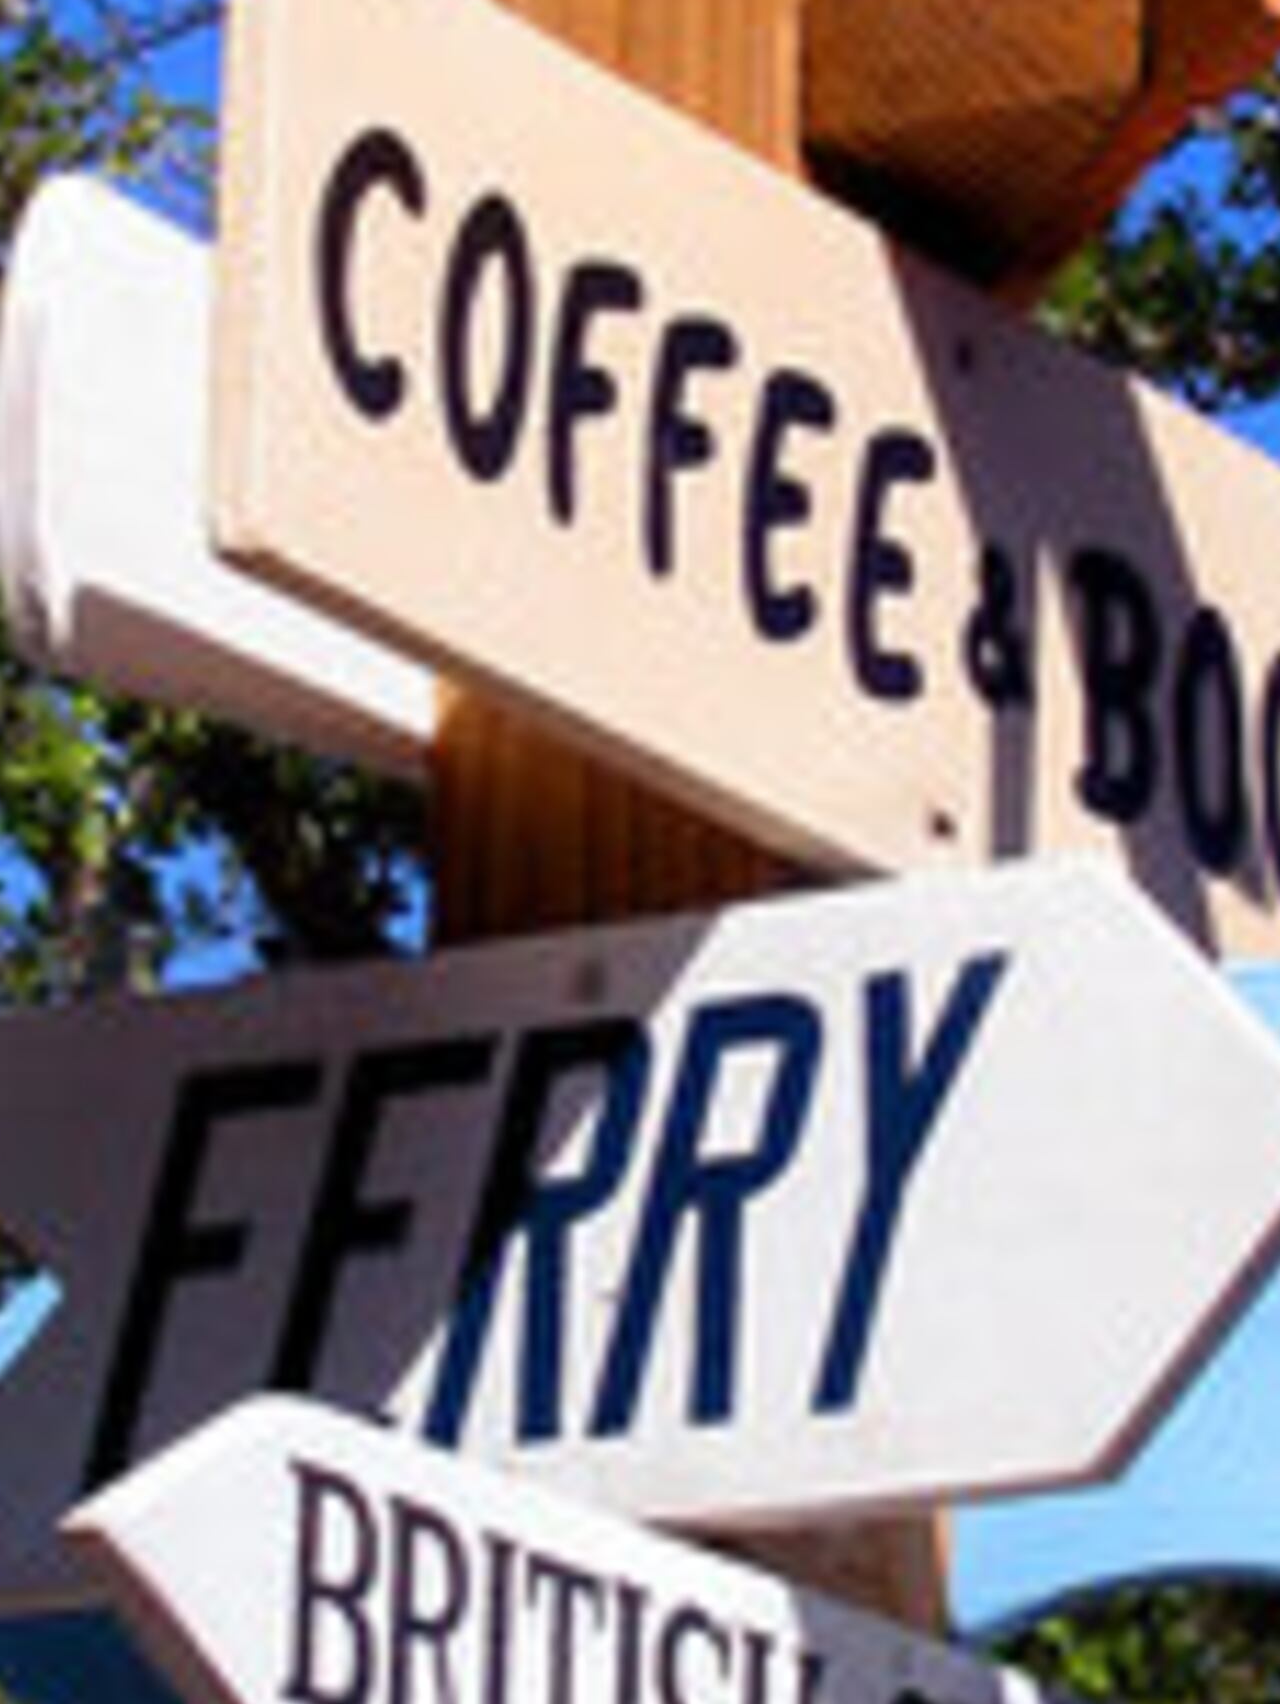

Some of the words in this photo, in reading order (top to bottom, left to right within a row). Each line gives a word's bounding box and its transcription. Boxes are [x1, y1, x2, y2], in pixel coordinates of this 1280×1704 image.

[313, 126, 936, 704] COFFEE
[963, 540, 1036, 710] &
[82, 949, 1012, 1494] FERRY
